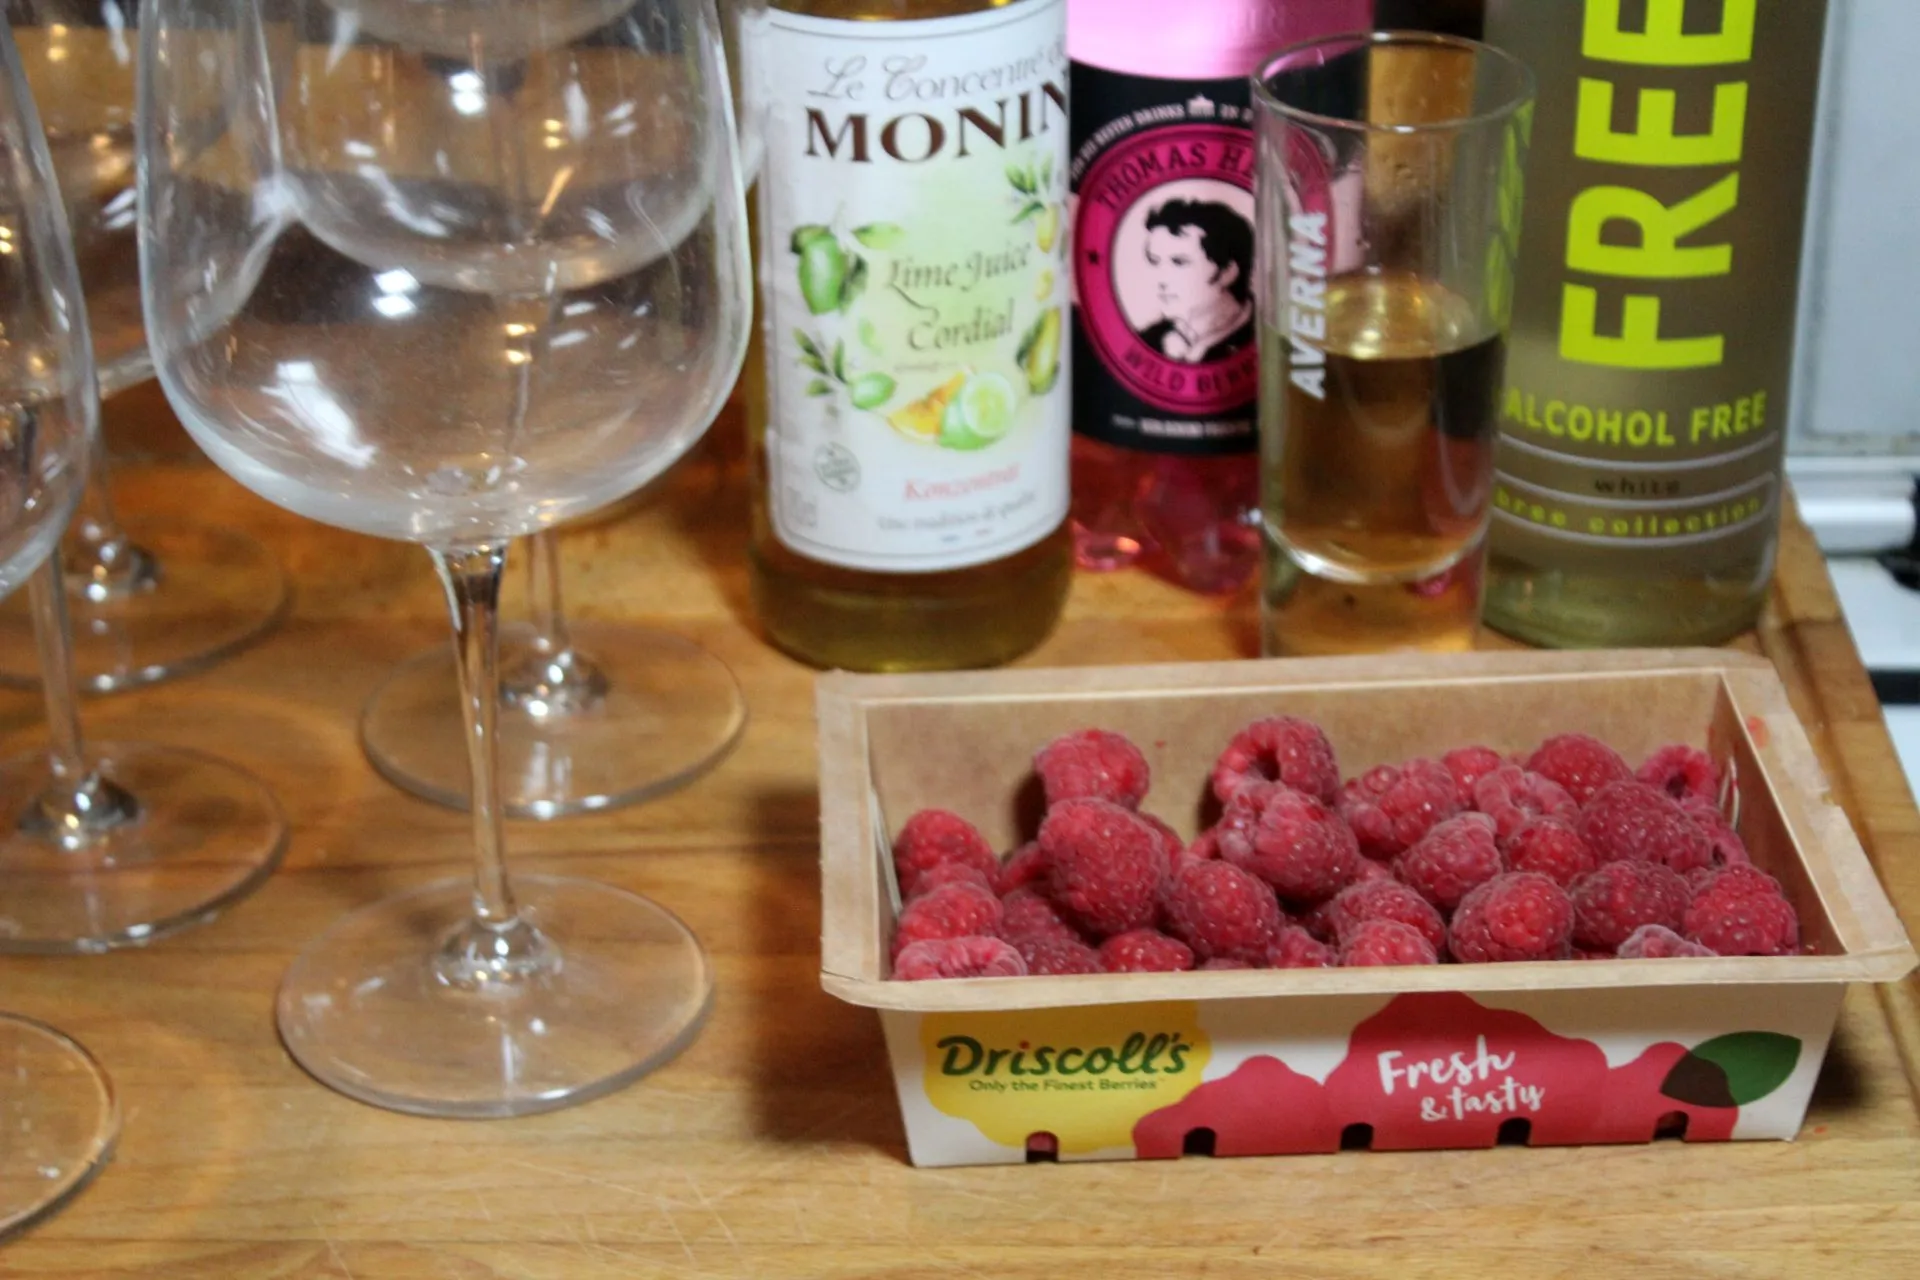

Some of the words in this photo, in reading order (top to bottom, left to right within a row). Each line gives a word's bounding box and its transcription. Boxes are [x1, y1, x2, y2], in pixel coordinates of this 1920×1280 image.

[807, 55, 867, 100] Le
[804, 80, 1067, 163] MONIN
[1097, 141, 1208, 211] THOMAS
[1559, 0, 1757, 370] FREE
[884, 256, 960, 298] Lime
[907, 297, 1015, 351] Cordial
[1288, 211, 1327, 401] AVERNA
[1503, 387, 1676, 446] ALCOHOL
[1690, 388, 1768, 445] FREE
[1595, 477, 1681, 497] white
[1588, 498, 1760, 537] collection
[936, 1031, 1193, 1076] Driscoll's
[1376, 1033, 1516, 1096] Fresh
[969, 1078, 1007, 1092] Only
[1012, 1079, 1040, 1091] the
[1043, 1078, 1095, 1091] Finest
[1099, 1077, 1158, 1090] Berries
[1446, 1075, 1546, 1121] tasty
